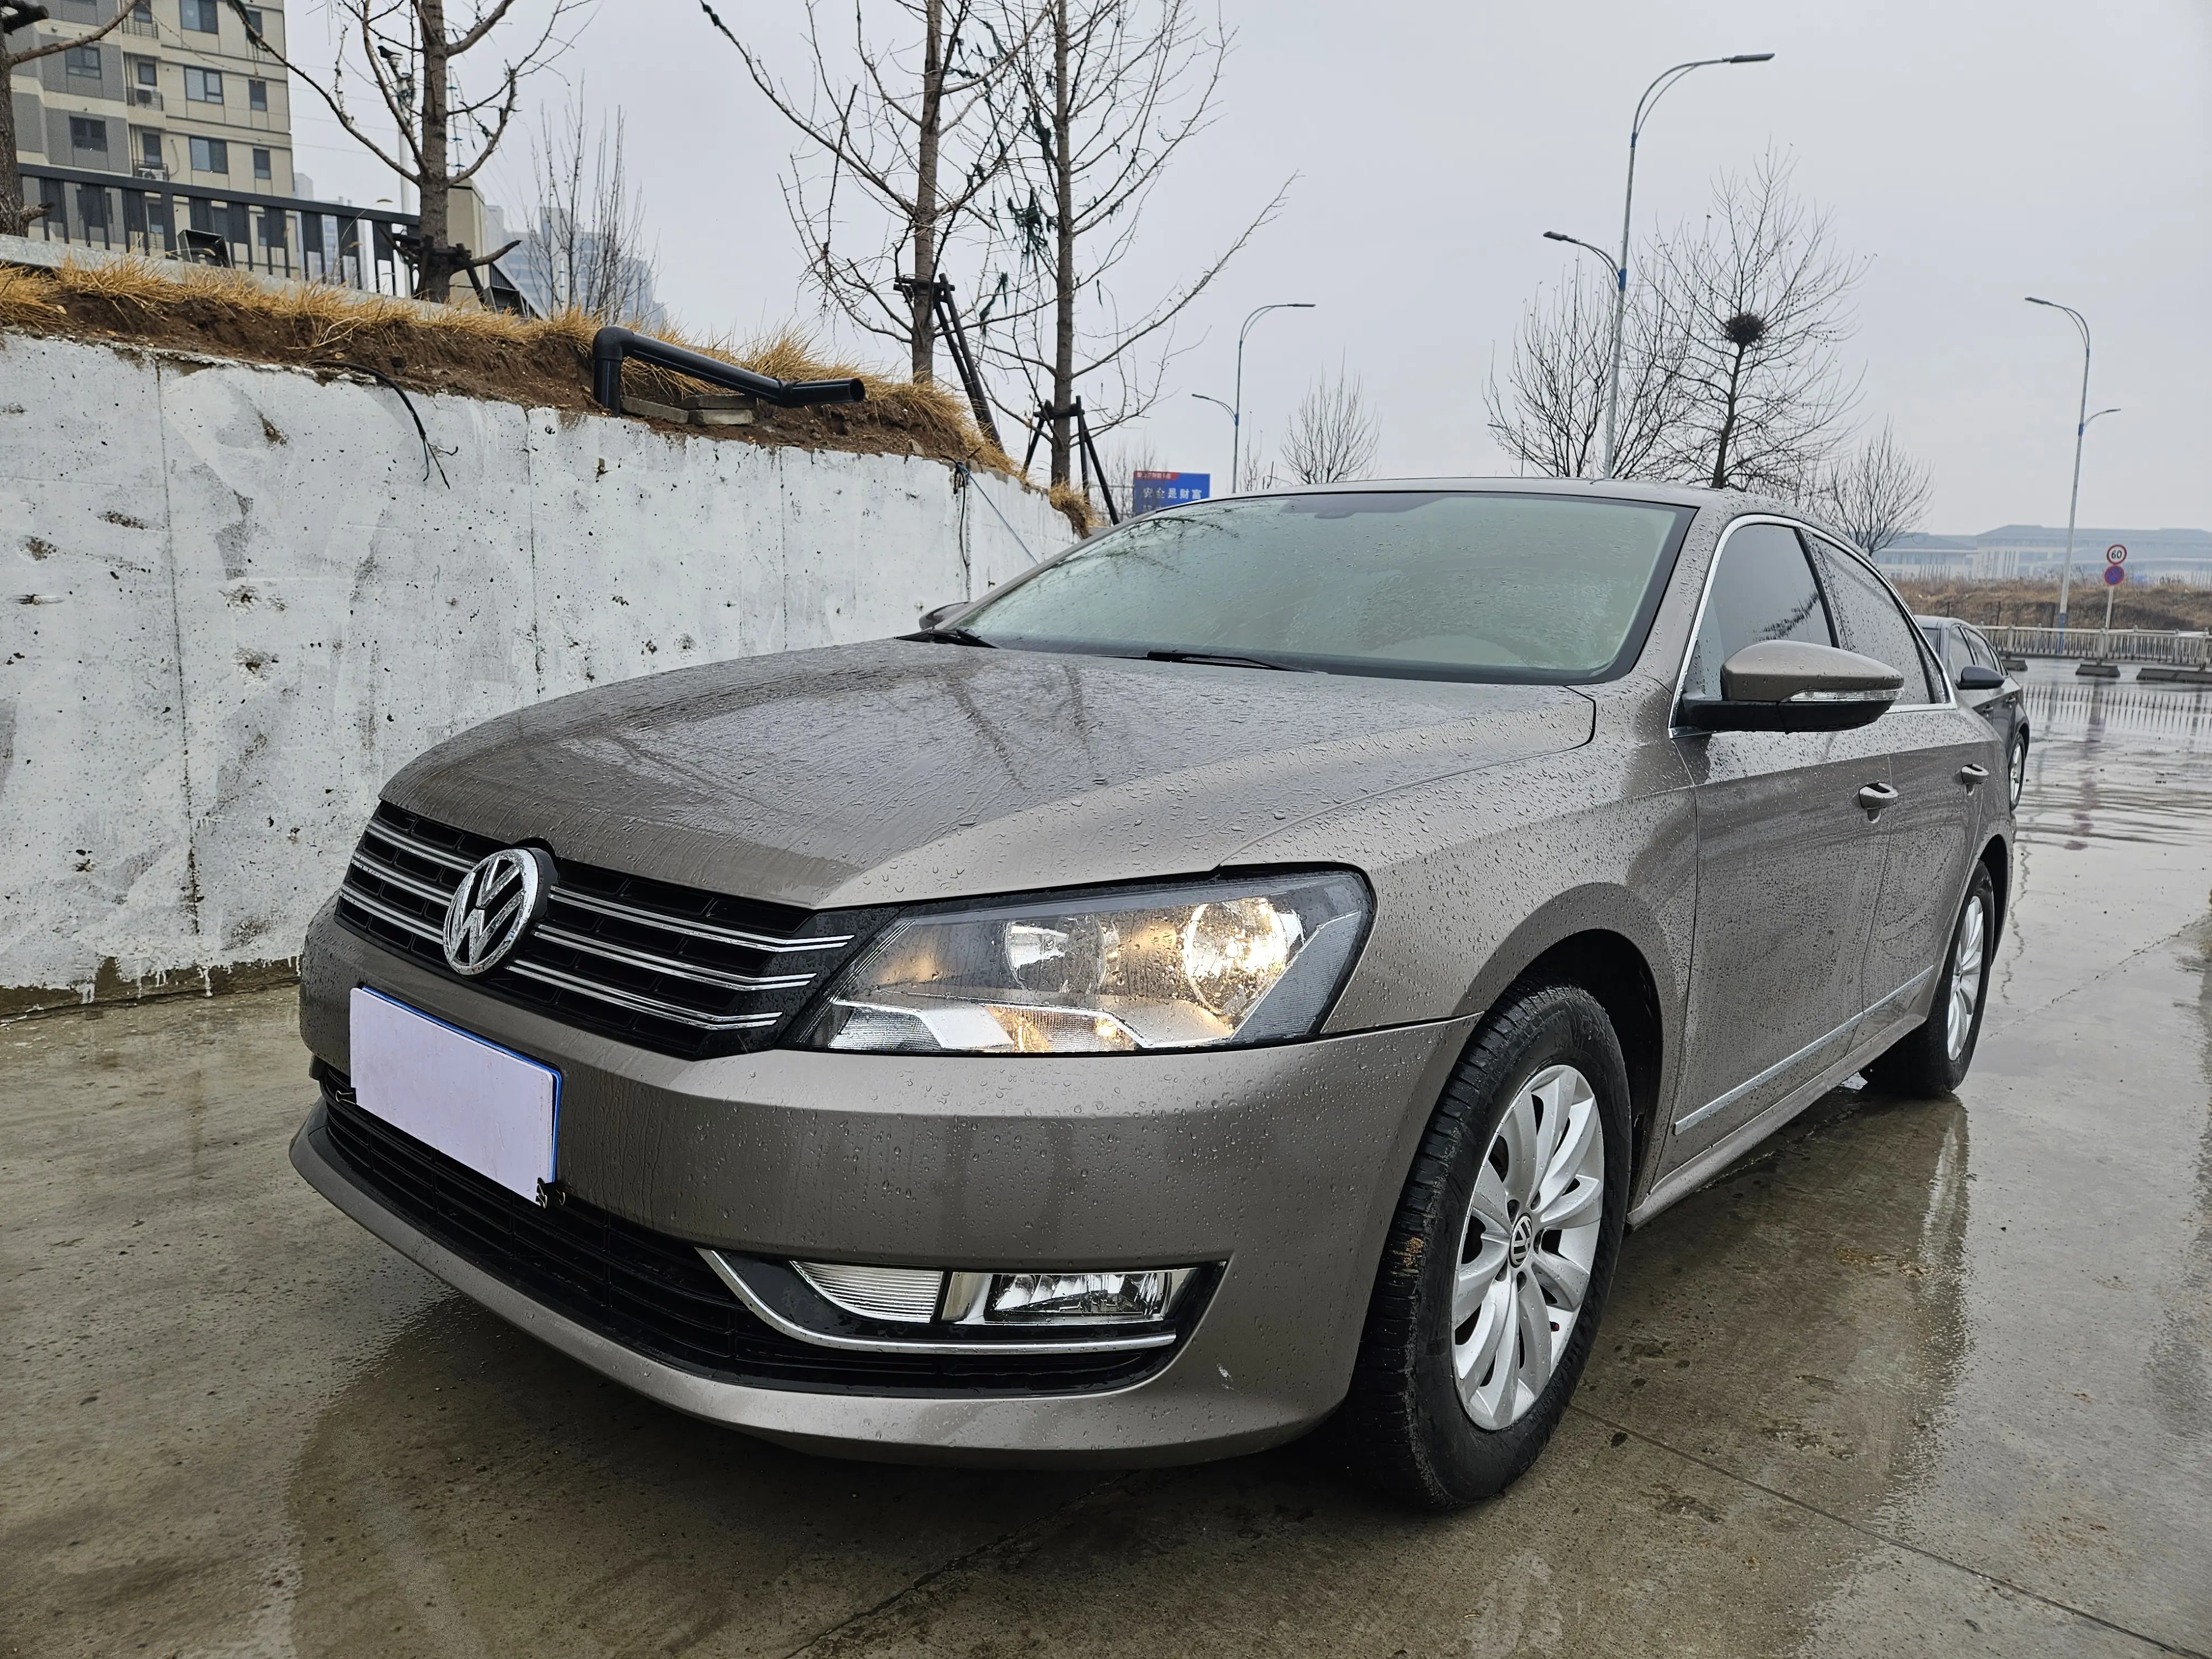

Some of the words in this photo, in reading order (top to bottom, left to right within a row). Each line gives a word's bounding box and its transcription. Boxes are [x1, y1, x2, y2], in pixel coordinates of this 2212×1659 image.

[1143, 487, 1202, 500] 安全是财富
[2111, 549, 2122, 560] 60
